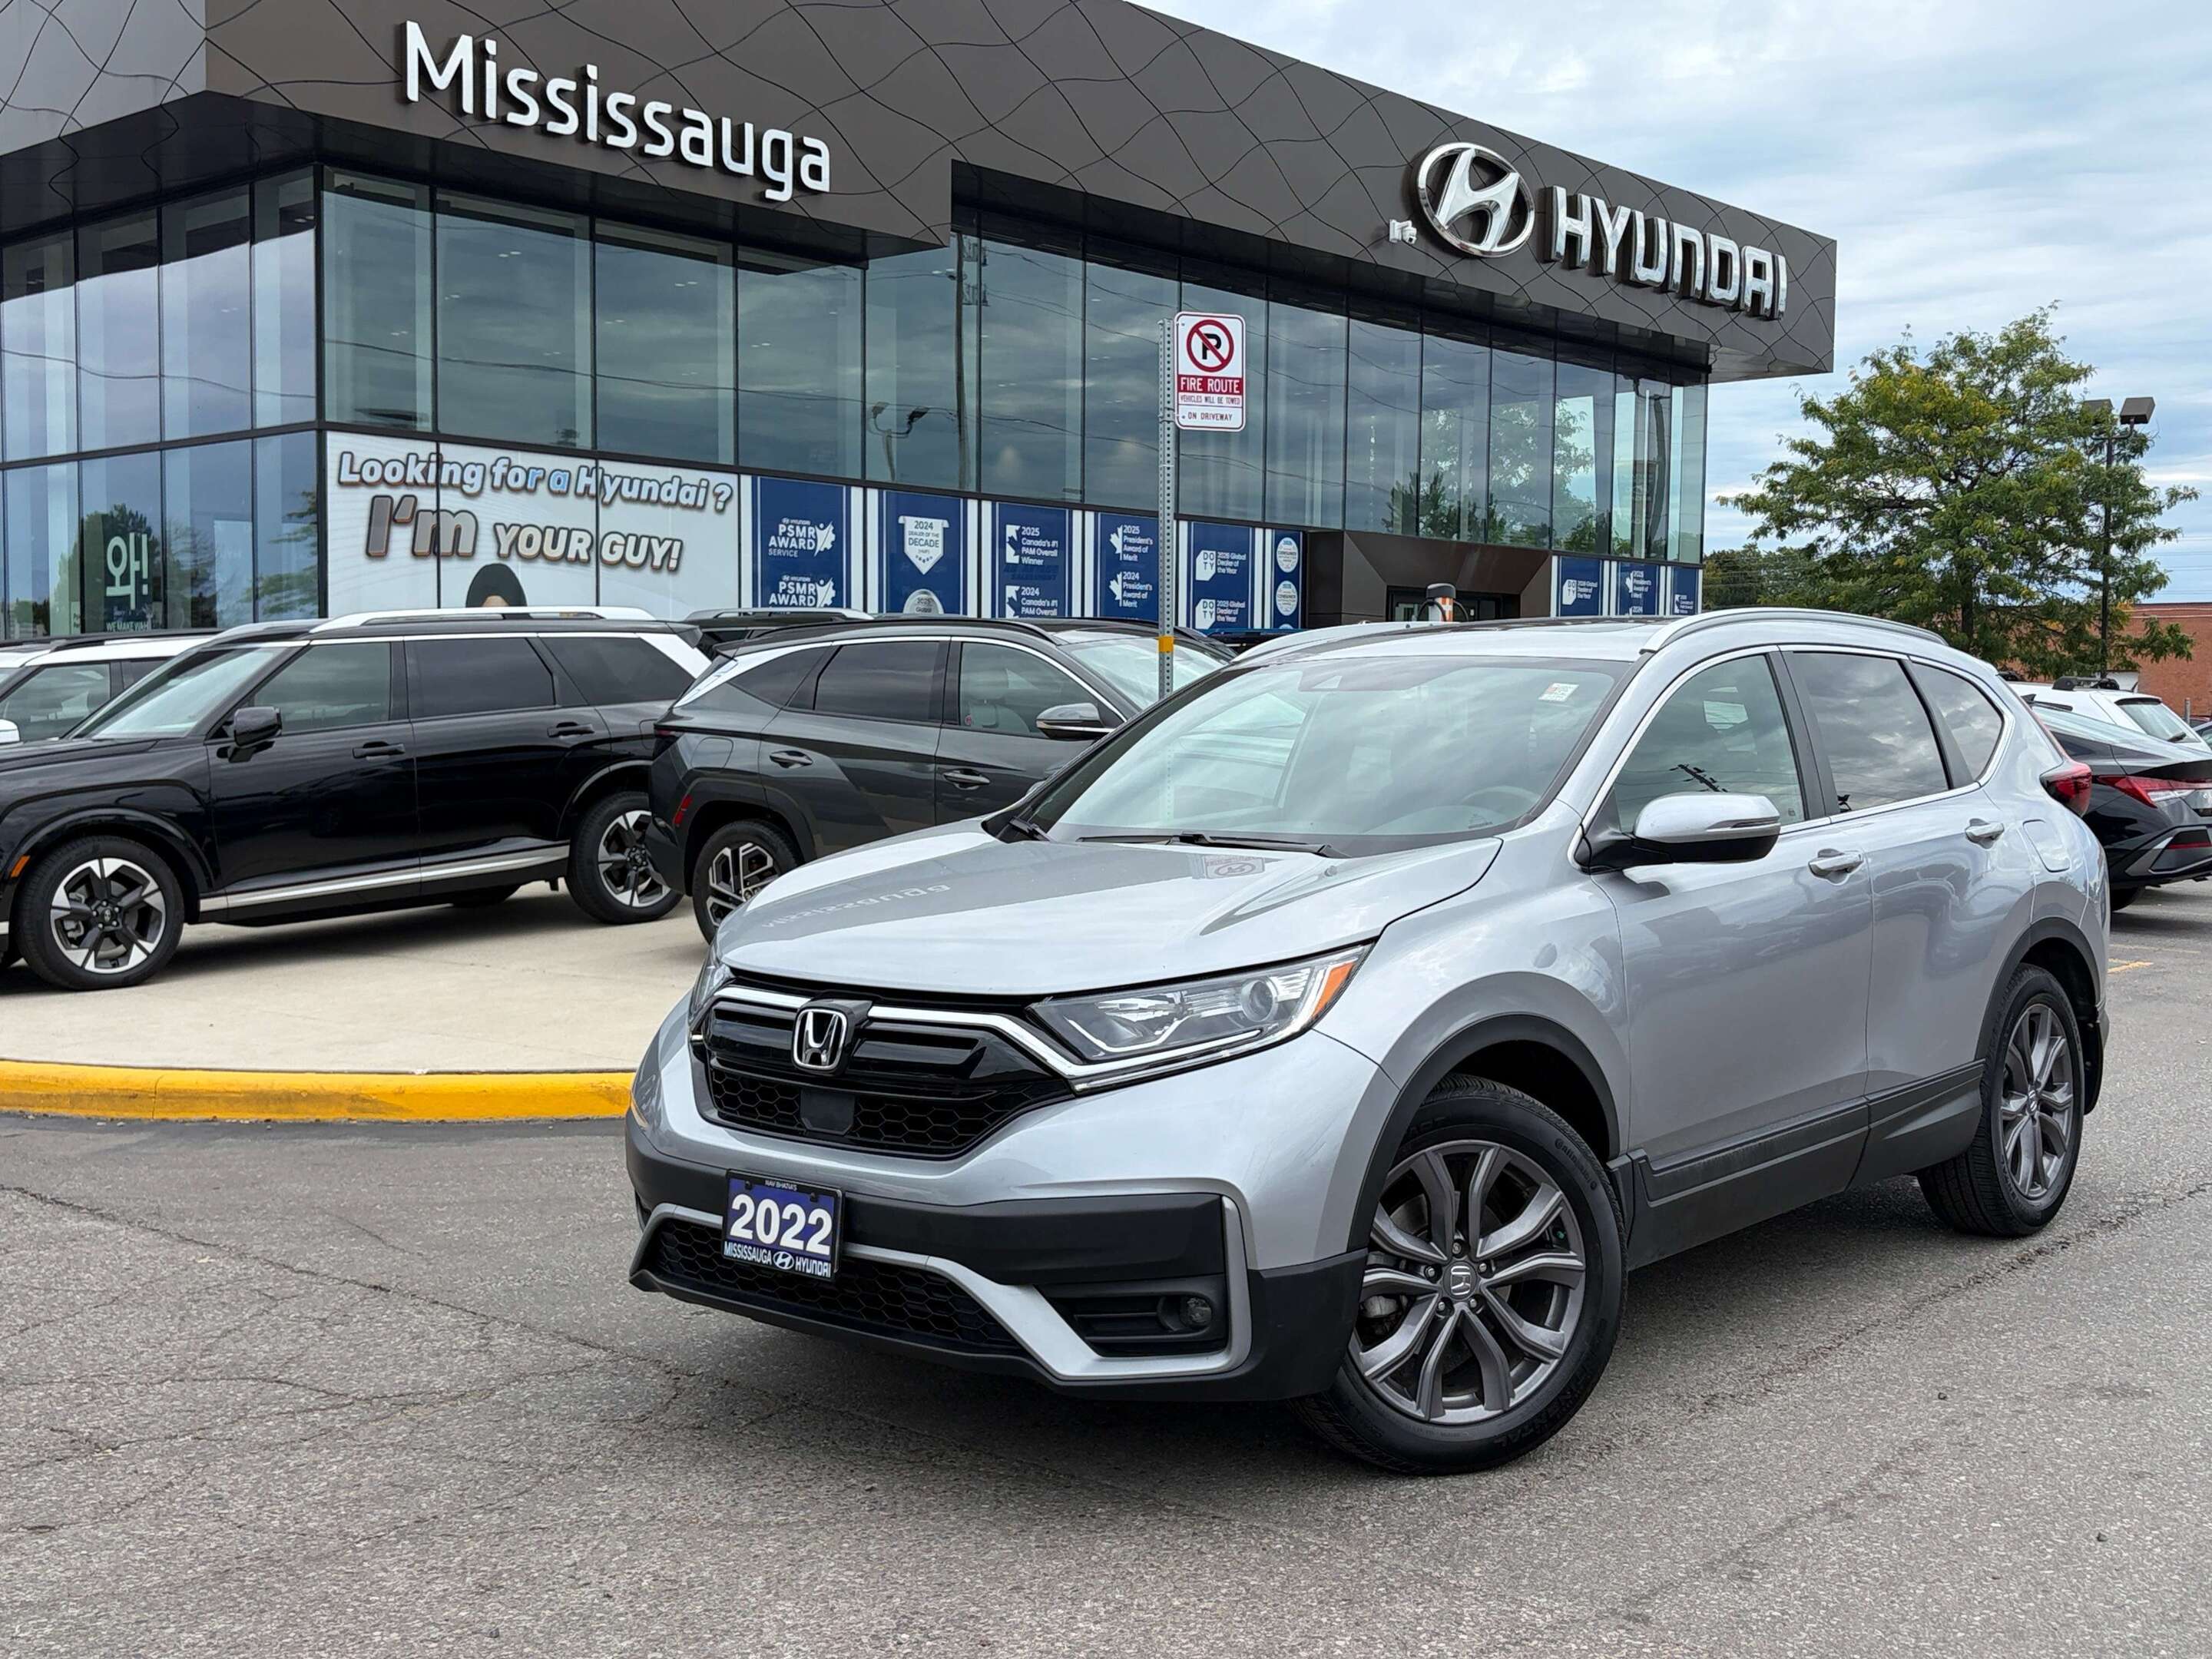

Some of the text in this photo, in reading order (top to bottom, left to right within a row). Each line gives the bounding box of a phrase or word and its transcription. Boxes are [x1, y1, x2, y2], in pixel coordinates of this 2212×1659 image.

[405, 20, 830, 202] Mississauga
[1551, 185, 1787, 320] HYUNDAI
[1181, 377, 1240, 393] FIRE ROUTE
[1181, 394, 1202, 402] VEHICLES
[1226, 397, 1240, 406] TOWED
[1200, 412, 1232, 421] DRIVEWAY
[339, 452, 484, 495] Looking
[492, 457, 543, 492] for
[548, 468, 569, 495] a
[914, 521, 933, 530] 2024
[1124, 525, 1140, 535] 2025
[366, 495, 684, 572] I'm YOUR GUY!
[779, 524, 816, 538] PSMR
[1022, 526, 1040, 536] 2025
[769, 535, 815, 550] AWARD
[908, 538, 939, 548] DECADE
[1022, 538, 1051, 547] Canada's
[1124, 535, 1153, 545] President's
[769, 548, 798, 558] SERVICE
[1022, 546, 1058, 557] PAM Overall
[1124, 545, 1141, 553] Award
[1021, 556, 1044, 565] Winner
[1123, 571, 1140, 580] 2024
[779, 581, 816, 595] PSMR
[1021, 587, 1040, 596] 2024
[1123, 582, 1153, 591] President's
[769, 593, 816, 606] AWARD
[106, 621, 117, 631] WE
[118, 621, 134, 631] MAKE
[730, 1194, 833, 1256] 2022
[724, 1241, 831, 1278] MISSISSAUGA HYUNDAI
